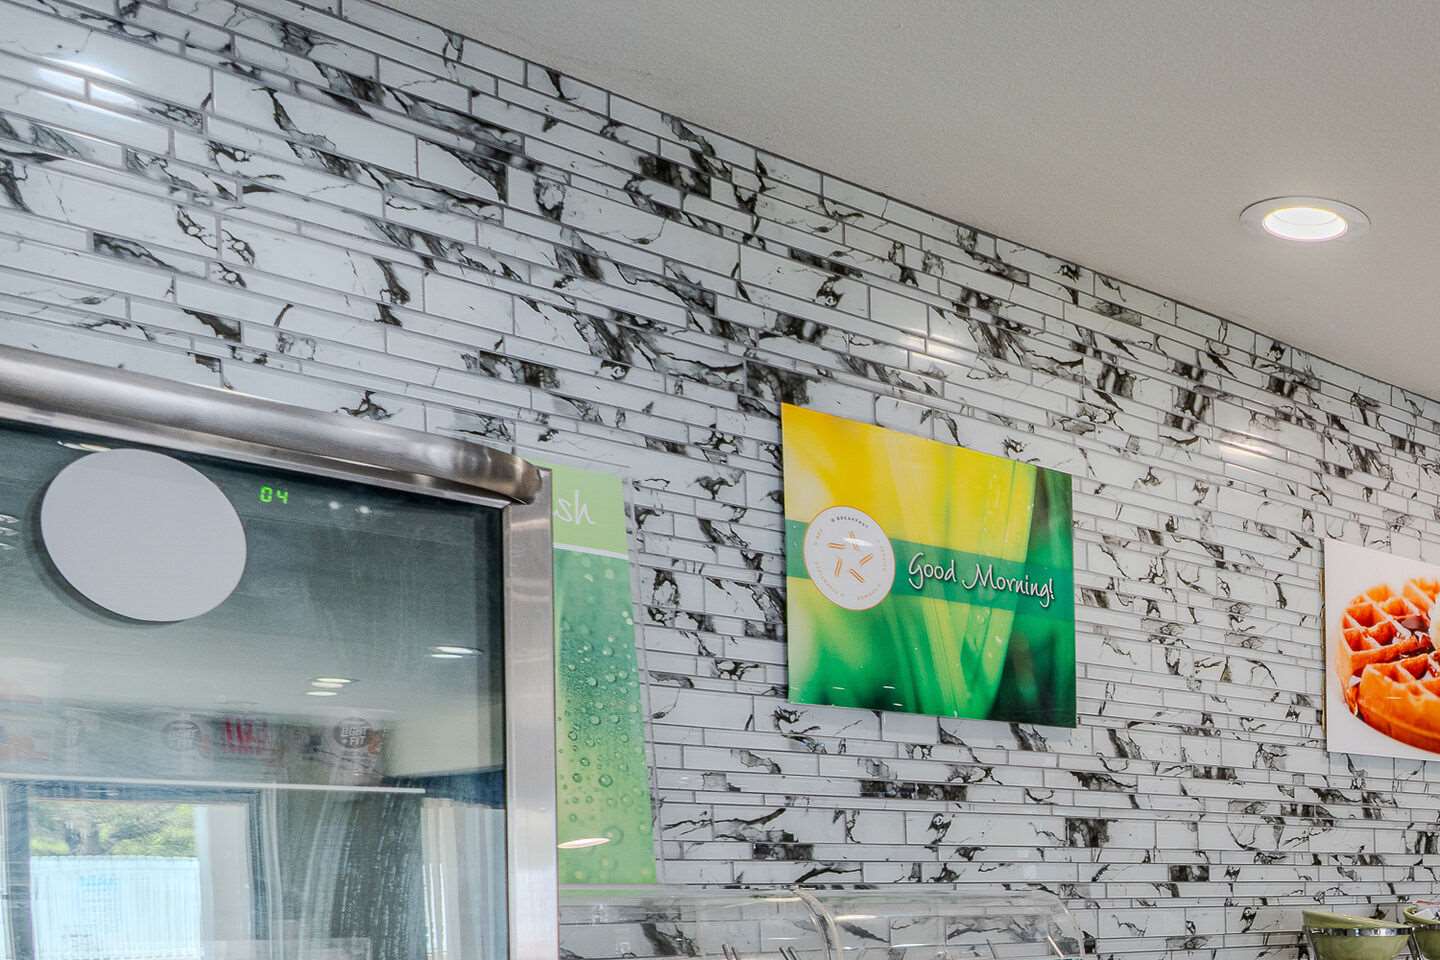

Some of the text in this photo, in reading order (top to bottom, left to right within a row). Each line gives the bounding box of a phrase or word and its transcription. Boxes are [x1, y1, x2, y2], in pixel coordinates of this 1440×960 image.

[260, 486, 289, 505] 04
[908, 551, 957, 590] Good
[961, 563, 1056, 608] Morning!
